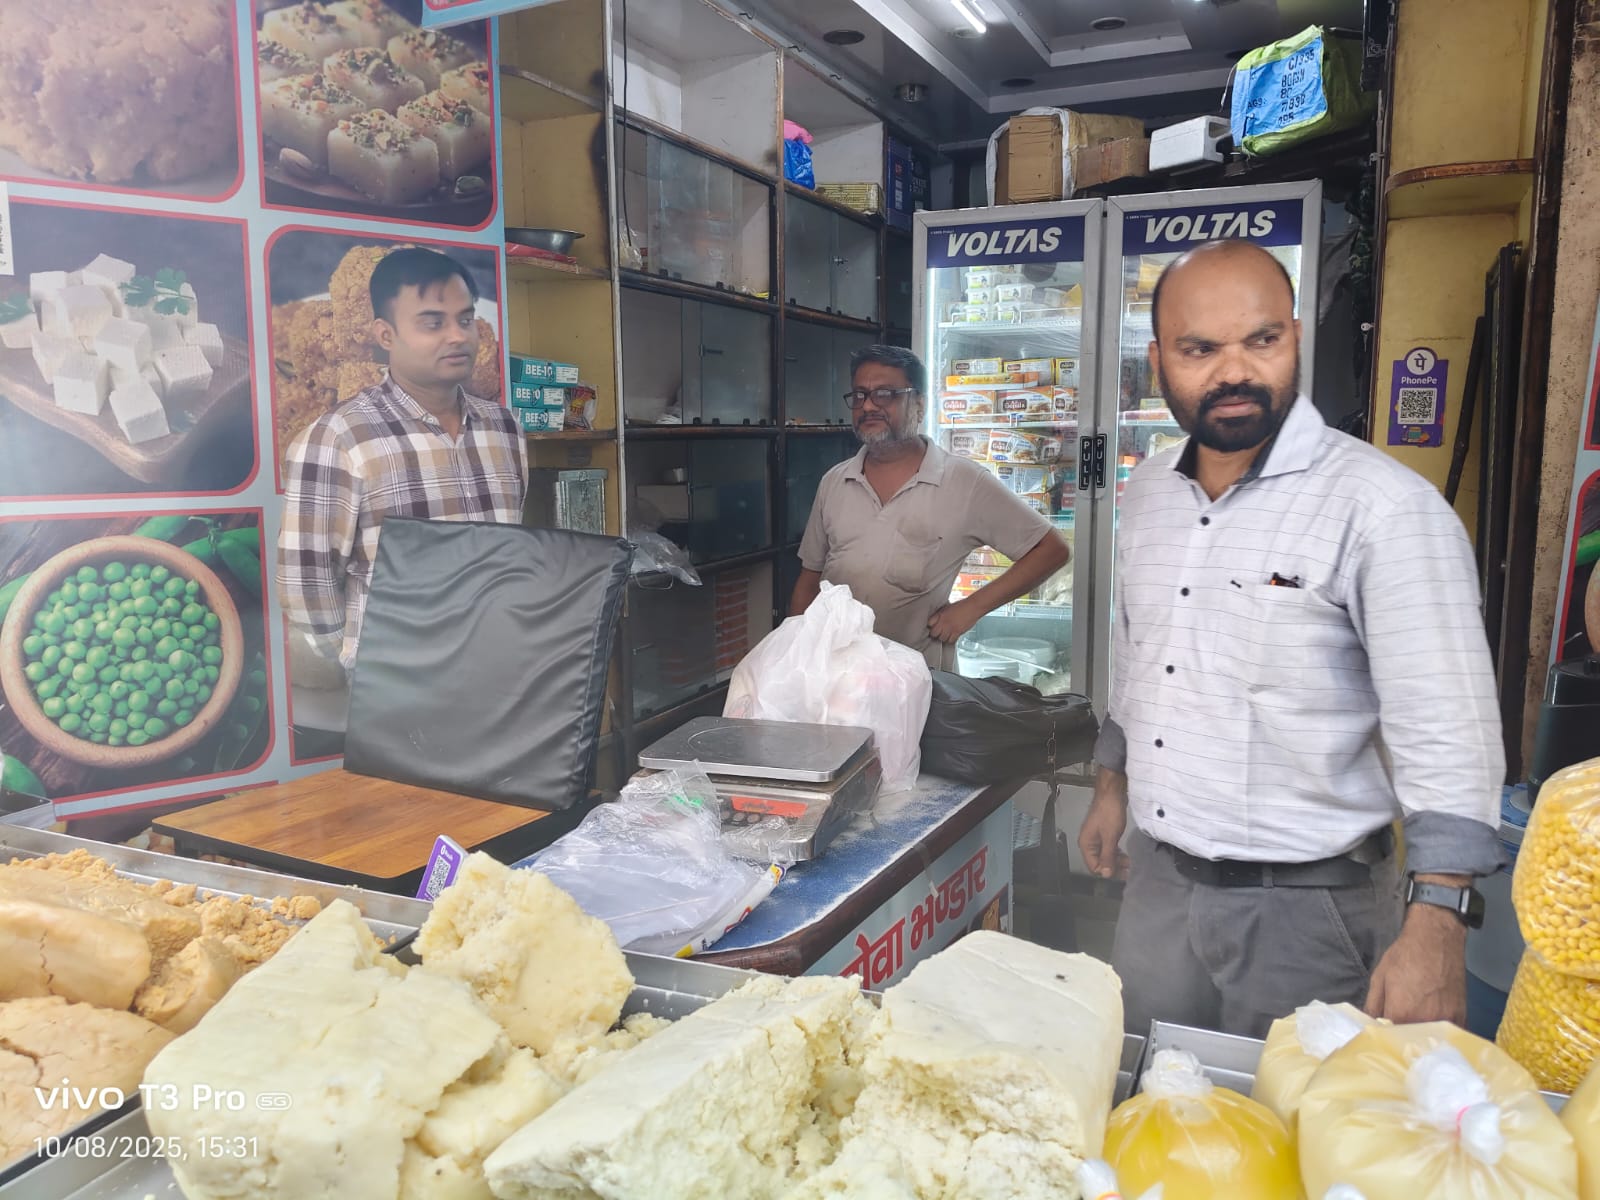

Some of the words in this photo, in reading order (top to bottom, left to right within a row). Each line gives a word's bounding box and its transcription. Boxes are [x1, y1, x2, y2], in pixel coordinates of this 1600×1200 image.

[1145, 208, 1277, 243] VOLTAS
[948, 226, 1062, 257] VOLTAS
[525, 364, 553, 377] BEE-10
[1401, 376, 1438, 385] PhonePe
[1083, 441, 1091, 485] PULL
